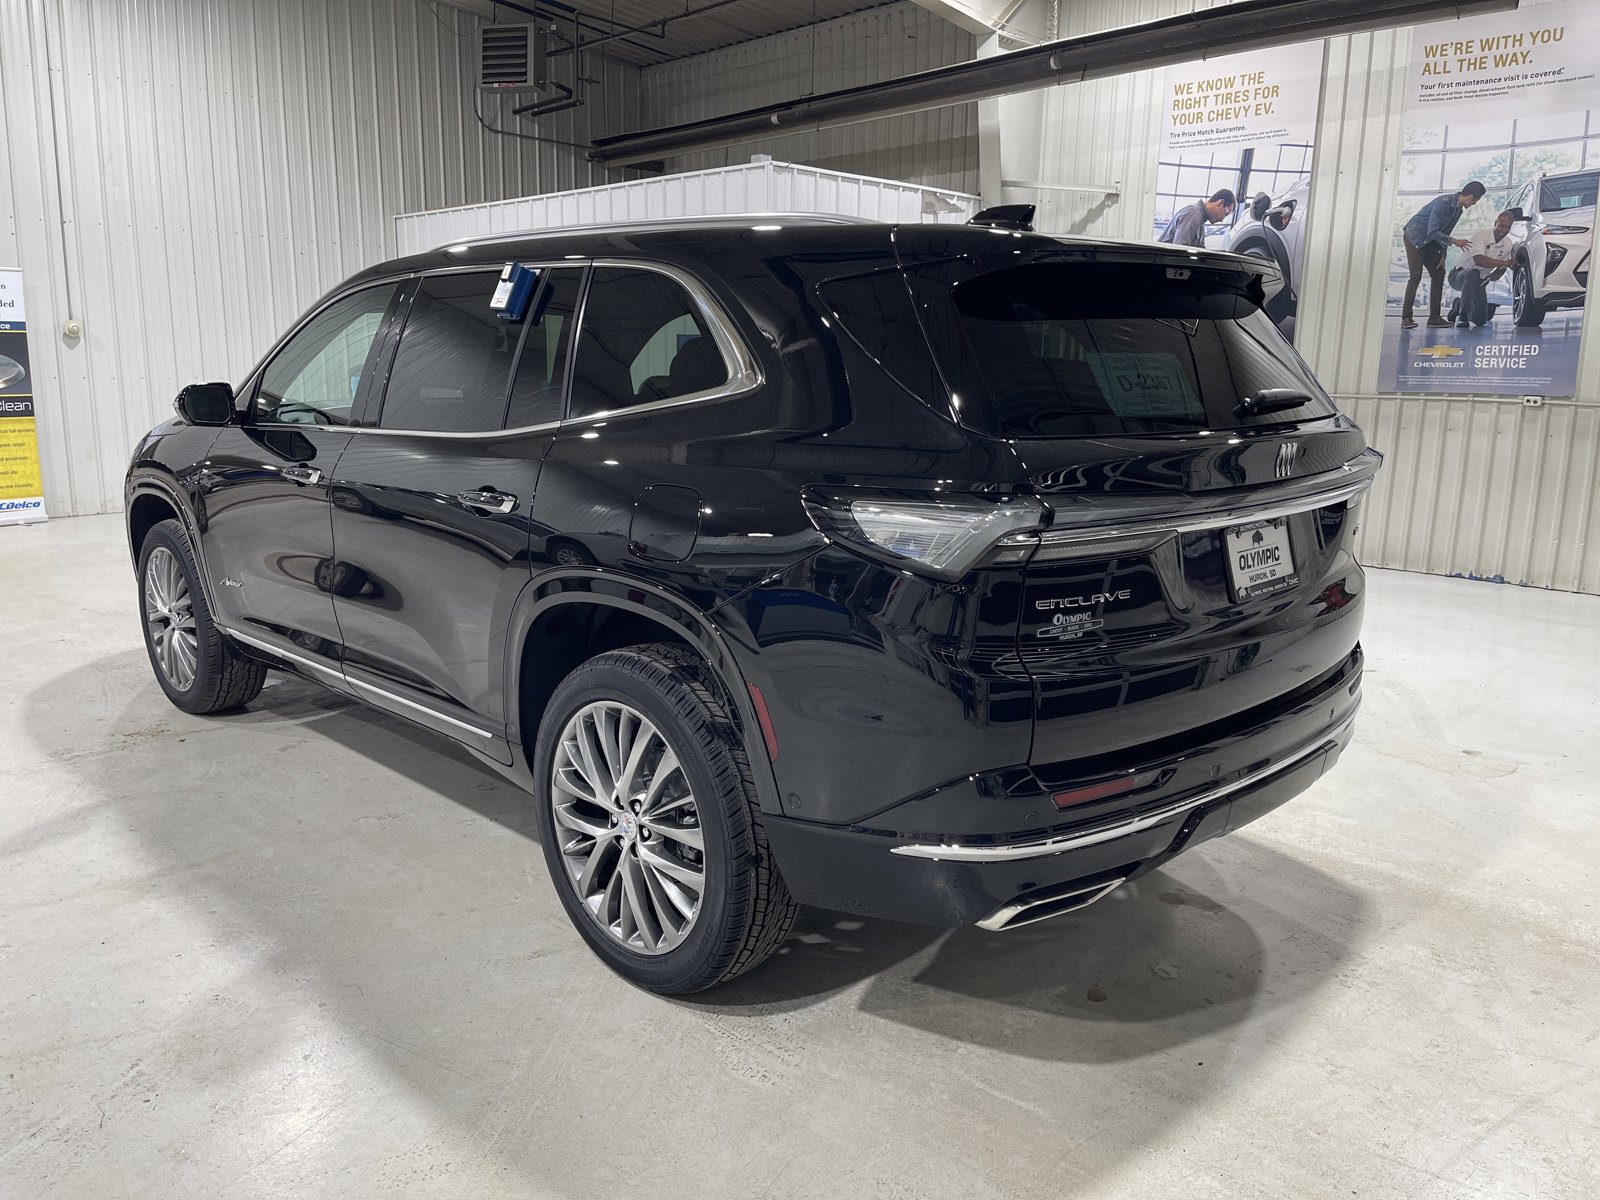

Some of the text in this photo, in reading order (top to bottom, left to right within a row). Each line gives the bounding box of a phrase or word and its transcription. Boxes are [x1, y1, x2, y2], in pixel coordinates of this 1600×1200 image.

[1480, 33, 1524, 52] WITH
[1529, 27, 1564, 45] YOU
[1422, 50, 1533, 76] ALL THE WAY.
[1174, 71, 1265, 96] WE KNOW THE
[1455, 76, 1502, 88] maintenance
[1504, 74, 1520, 82] visit
[1172, 85, 1279, 111] RIGHT TIRES FOR
[1172, 102, 1274, 126] YOUR CHEVY EV.
[1475, 345, 1539, 356] CERTIFIED
[1474, 357, 1527, 369] SERVICE
[1239, 546, 1280, 570] OLYMPIC
[1249, 569, 1276, 583] HURON, SD
[1036, 590, 1131, 609] ENCLAVE
